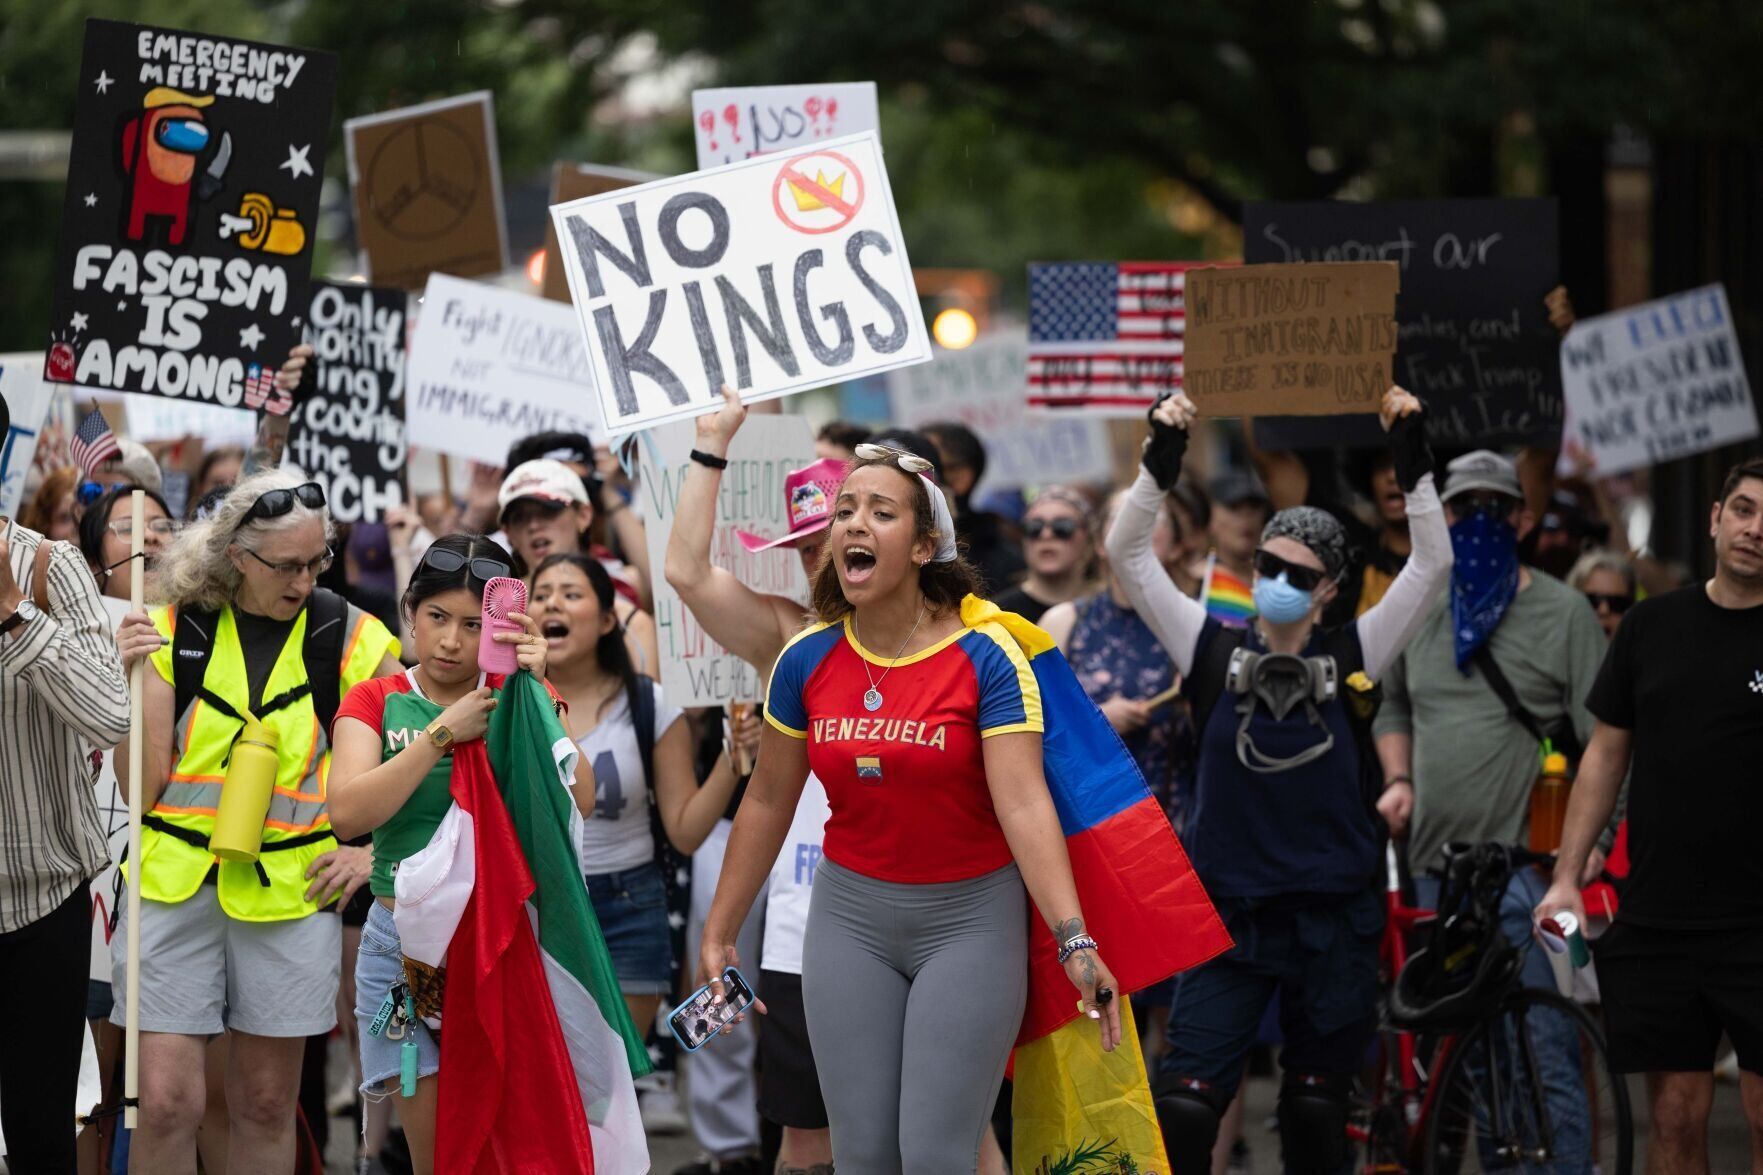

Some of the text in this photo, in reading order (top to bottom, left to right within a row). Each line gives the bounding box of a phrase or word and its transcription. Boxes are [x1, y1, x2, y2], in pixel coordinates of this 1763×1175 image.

[138, 30, 306, 88] EMERGENCY
[139, 62, 275, 104] MEETING
[566, 191, 730, 299] NO
[73, 244, 288, 316] FASCISM
[1191, 276, 1330, 326] WITHOUT
[138, 294, 208, 351] IS
[310, 286, 402, 375] Only
[441, 299, 503, 345] Fight
[592, 230, 909, 417] KINGS
[1271, 361, 1299, 389] IS
[1334, 360, 1387, 404] USA
[813, 717, 947, 751] VENEZUELA
